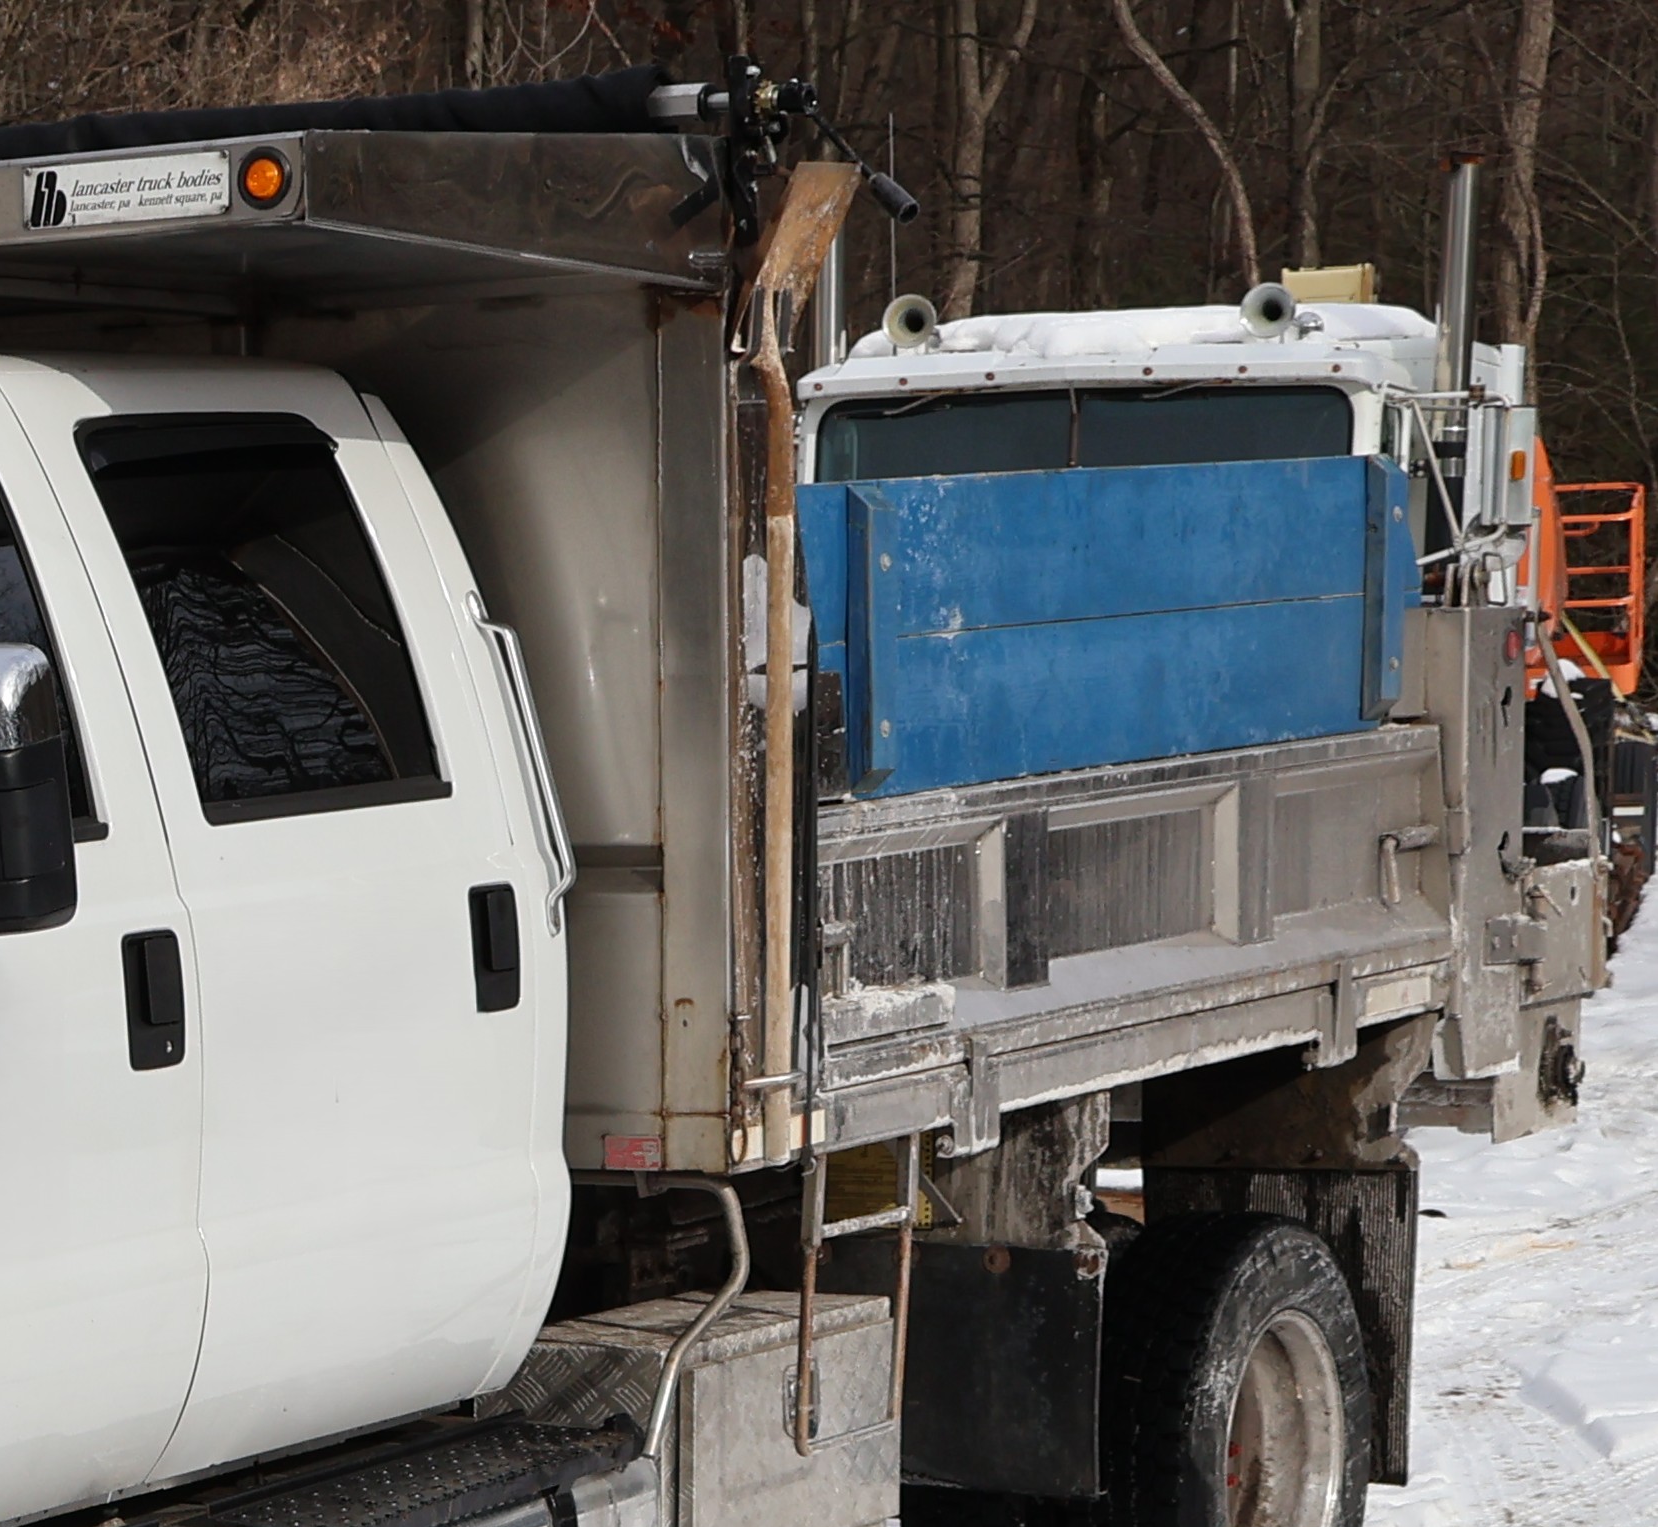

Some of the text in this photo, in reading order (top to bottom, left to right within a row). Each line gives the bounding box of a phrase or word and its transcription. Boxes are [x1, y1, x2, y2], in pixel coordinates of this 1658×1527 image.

[71, 169, 224, 197] lancaster truck bodies
[117, 201, 130, 212] pa
[210, 190, 223, 203] pa
